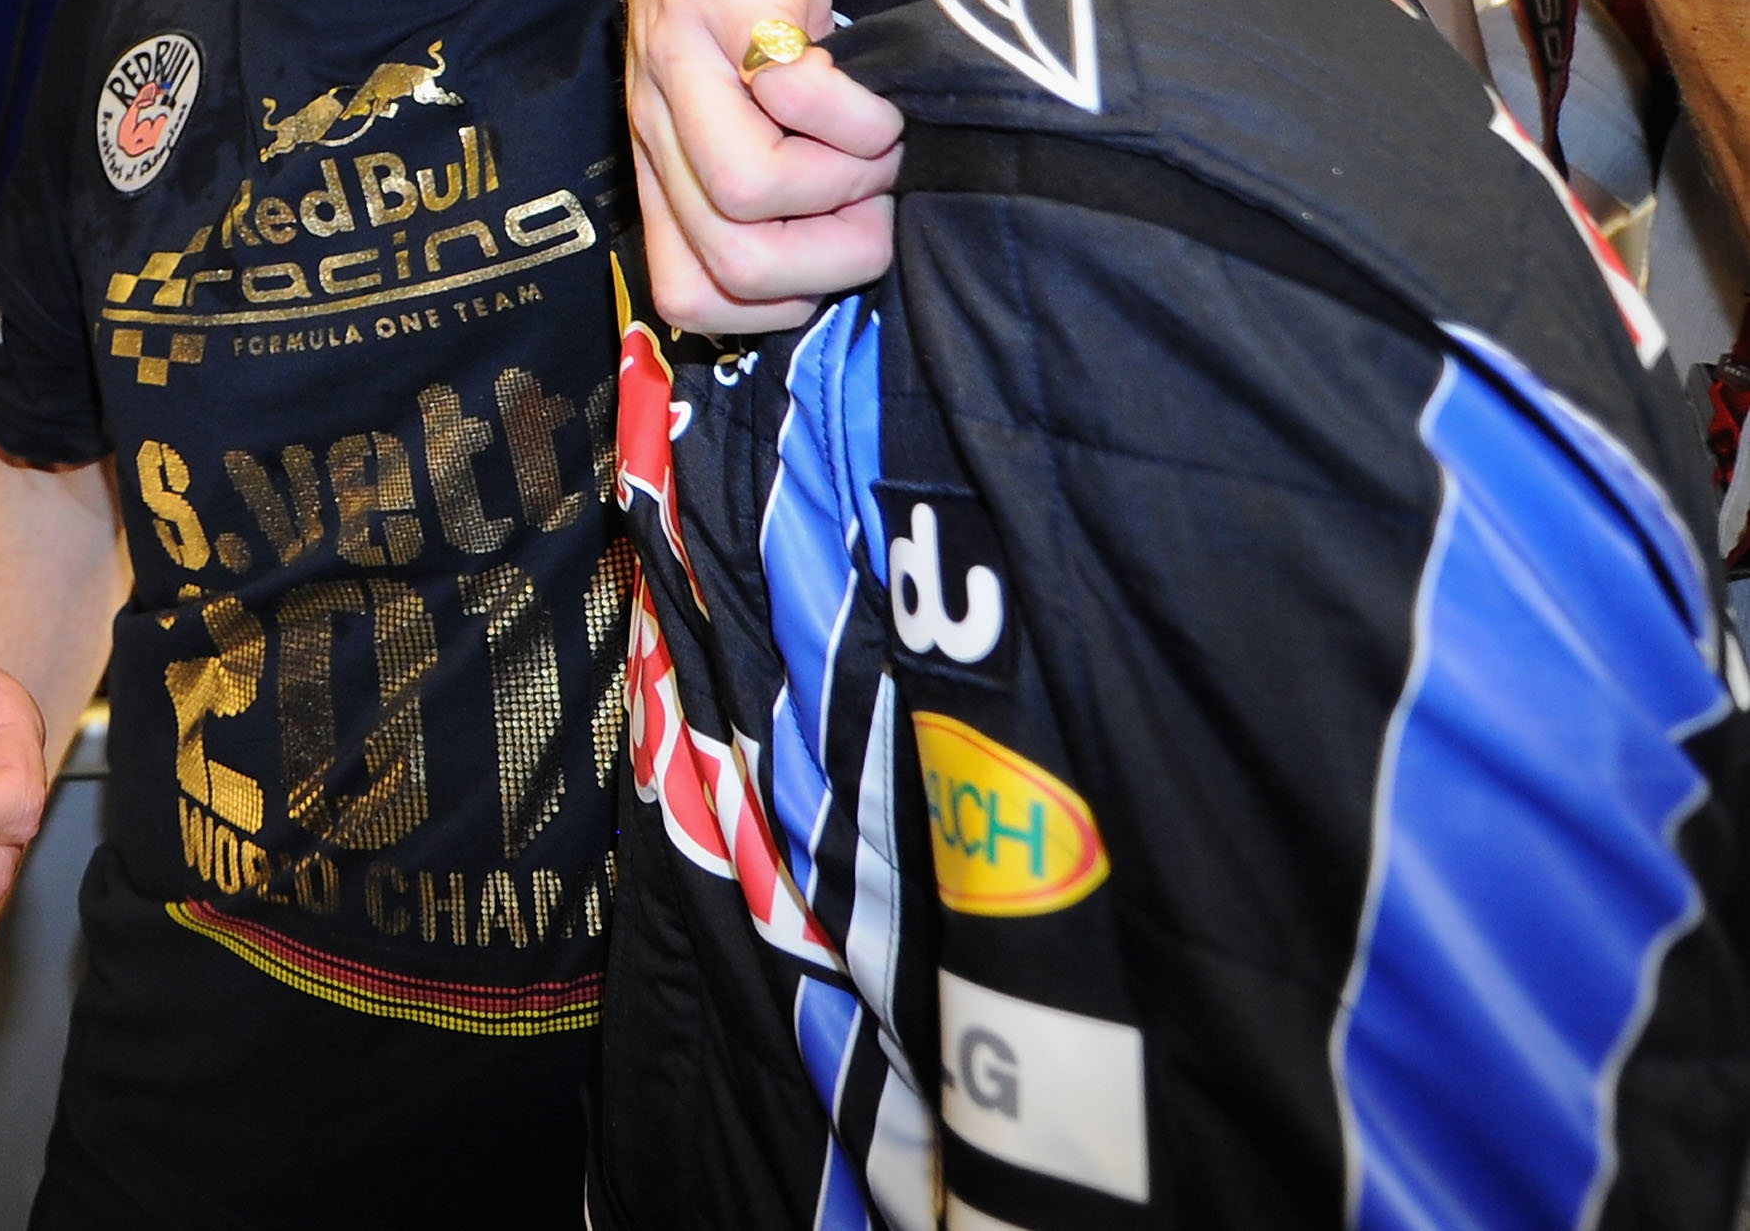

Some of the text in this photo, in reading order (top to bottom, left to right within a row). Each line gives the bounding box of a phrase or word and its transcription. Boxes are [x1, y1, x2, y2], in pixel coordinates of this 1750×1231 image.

[221, 125, 499, 250] Red Bull
[186, 188, 597, 307] racing
[233, 282, 545, 357] FORMULA ONE TEAM
